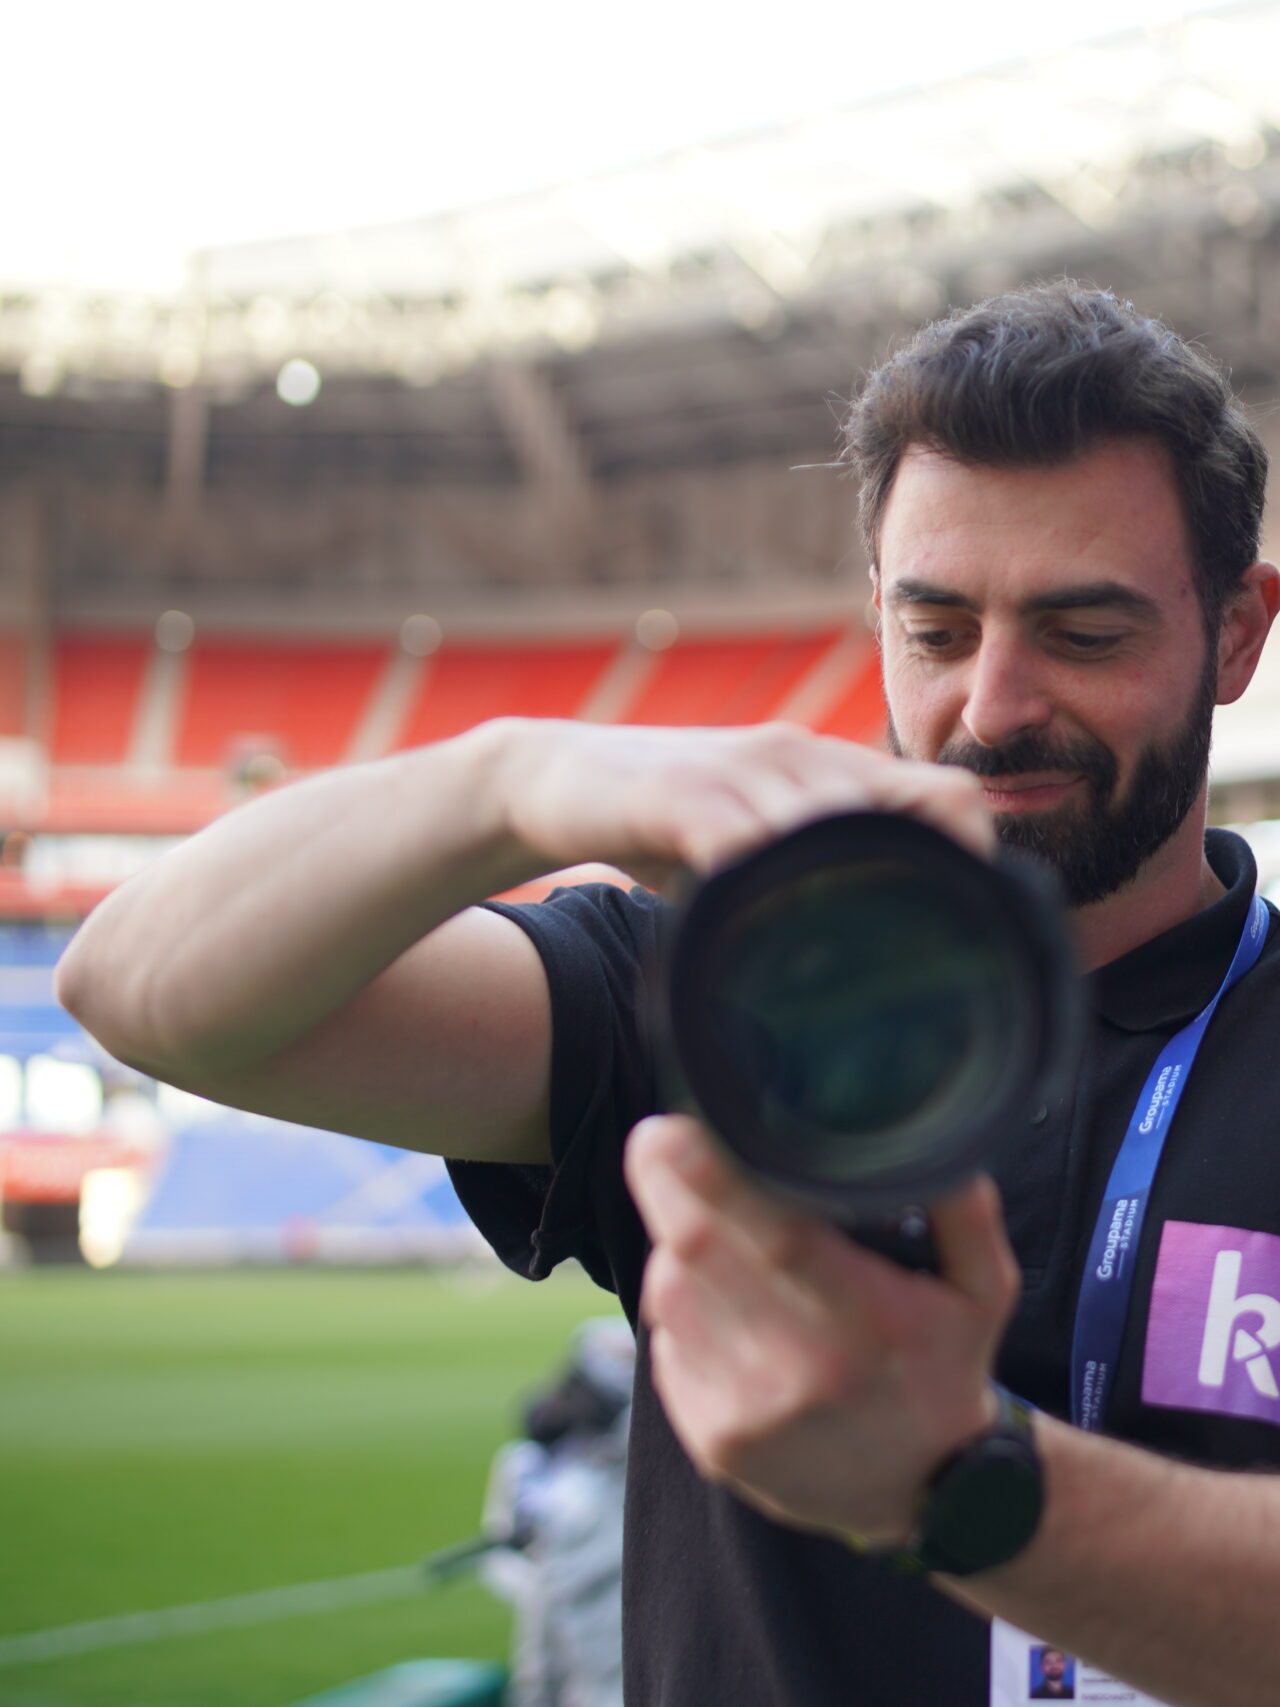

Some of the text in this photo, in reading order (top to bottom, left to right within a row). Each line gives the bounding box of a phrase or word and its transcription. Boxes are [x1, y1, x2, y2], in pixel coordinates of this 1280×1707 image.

[1139, 1066, 1172, 1132] Groupama
[1161, 1064, 1182, 1106] STADIUM
[1096, 1199, 1128, 1278] Groupama
[1120, 1199, 1139, 1248] STADIUM
[1082, 1360, 1098, 1429] oupama
